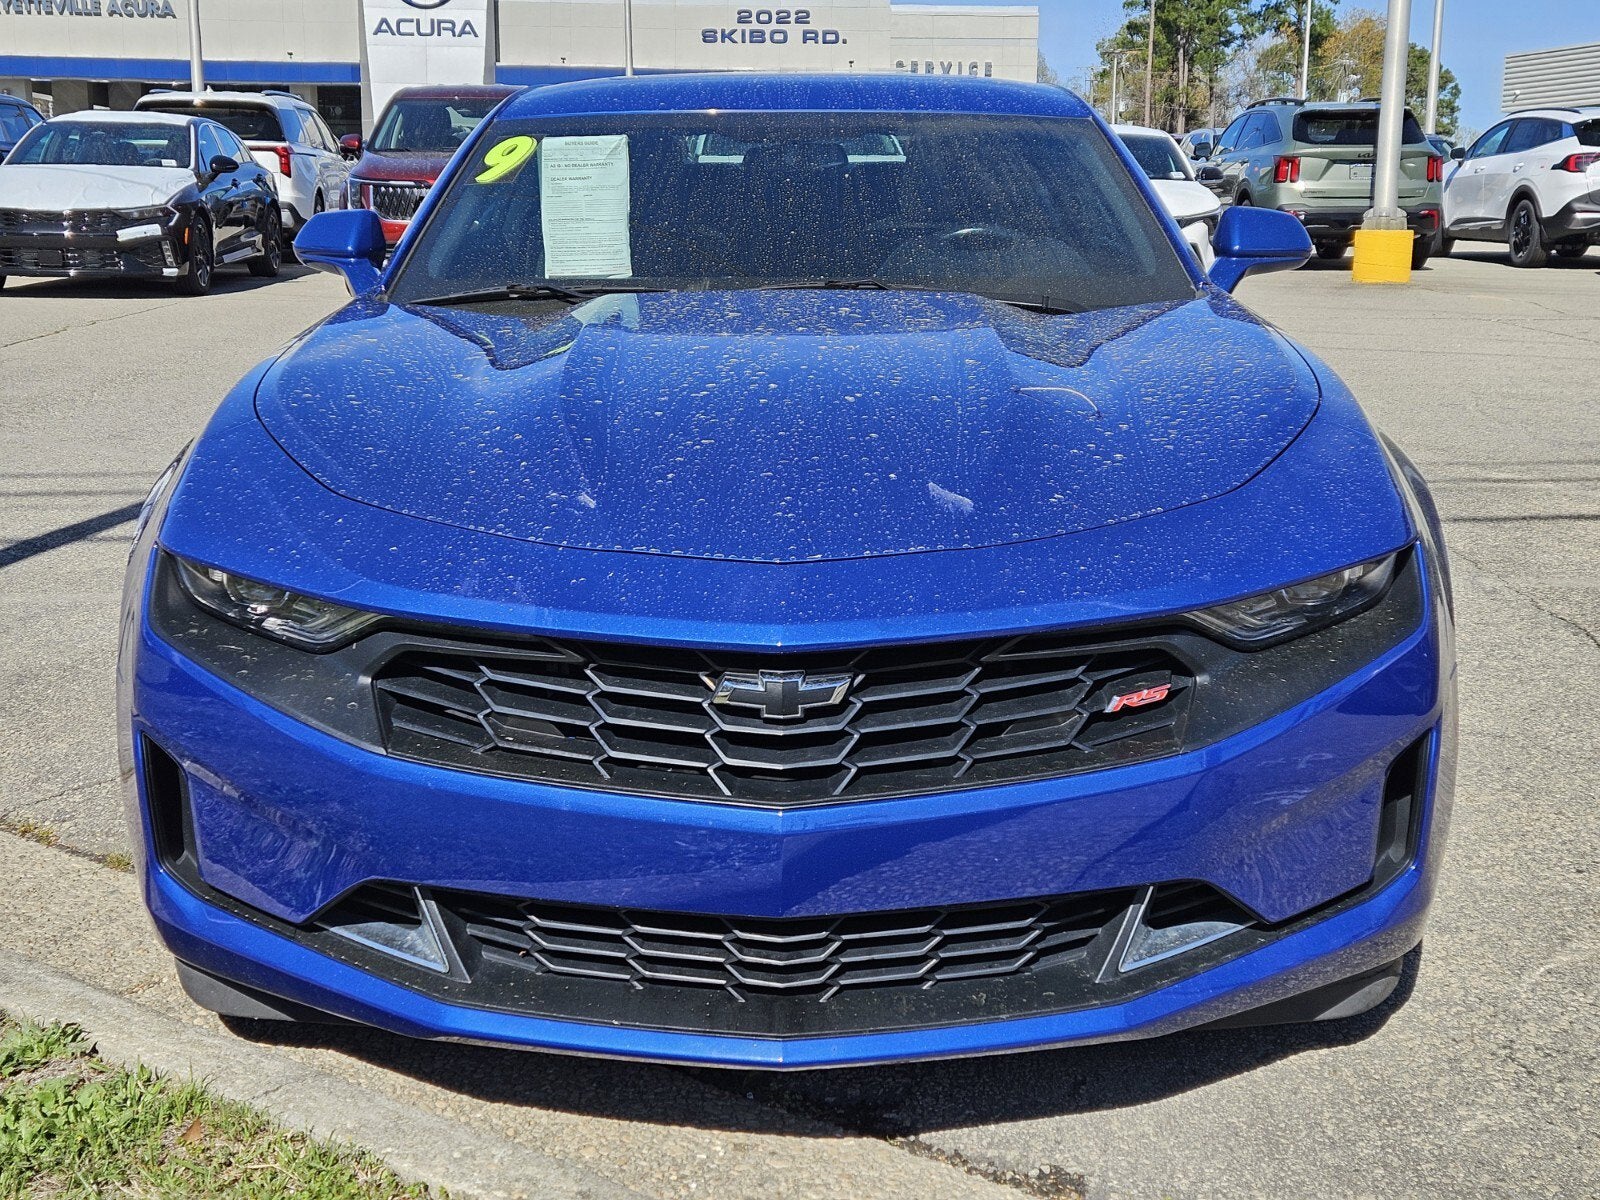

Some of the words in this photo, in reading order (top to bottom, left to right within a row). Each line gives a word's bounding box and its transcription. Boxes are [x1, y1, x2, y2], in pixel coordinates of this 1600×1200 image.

[0, 0, 102, 16] YETTEVILLE
[106, 0, 177, 19] ACURA
[736, 8, 811, 25] 2022
[372, 17, 479, 37] ACURA
[701, 28, 789, 44] SKIBO
[802, 29, 848, 45] RD.
[895, 60, 993, 77] SERVICE
[474, 135, 538, 183] 9
[1103, 683, 1171, 713] RS
